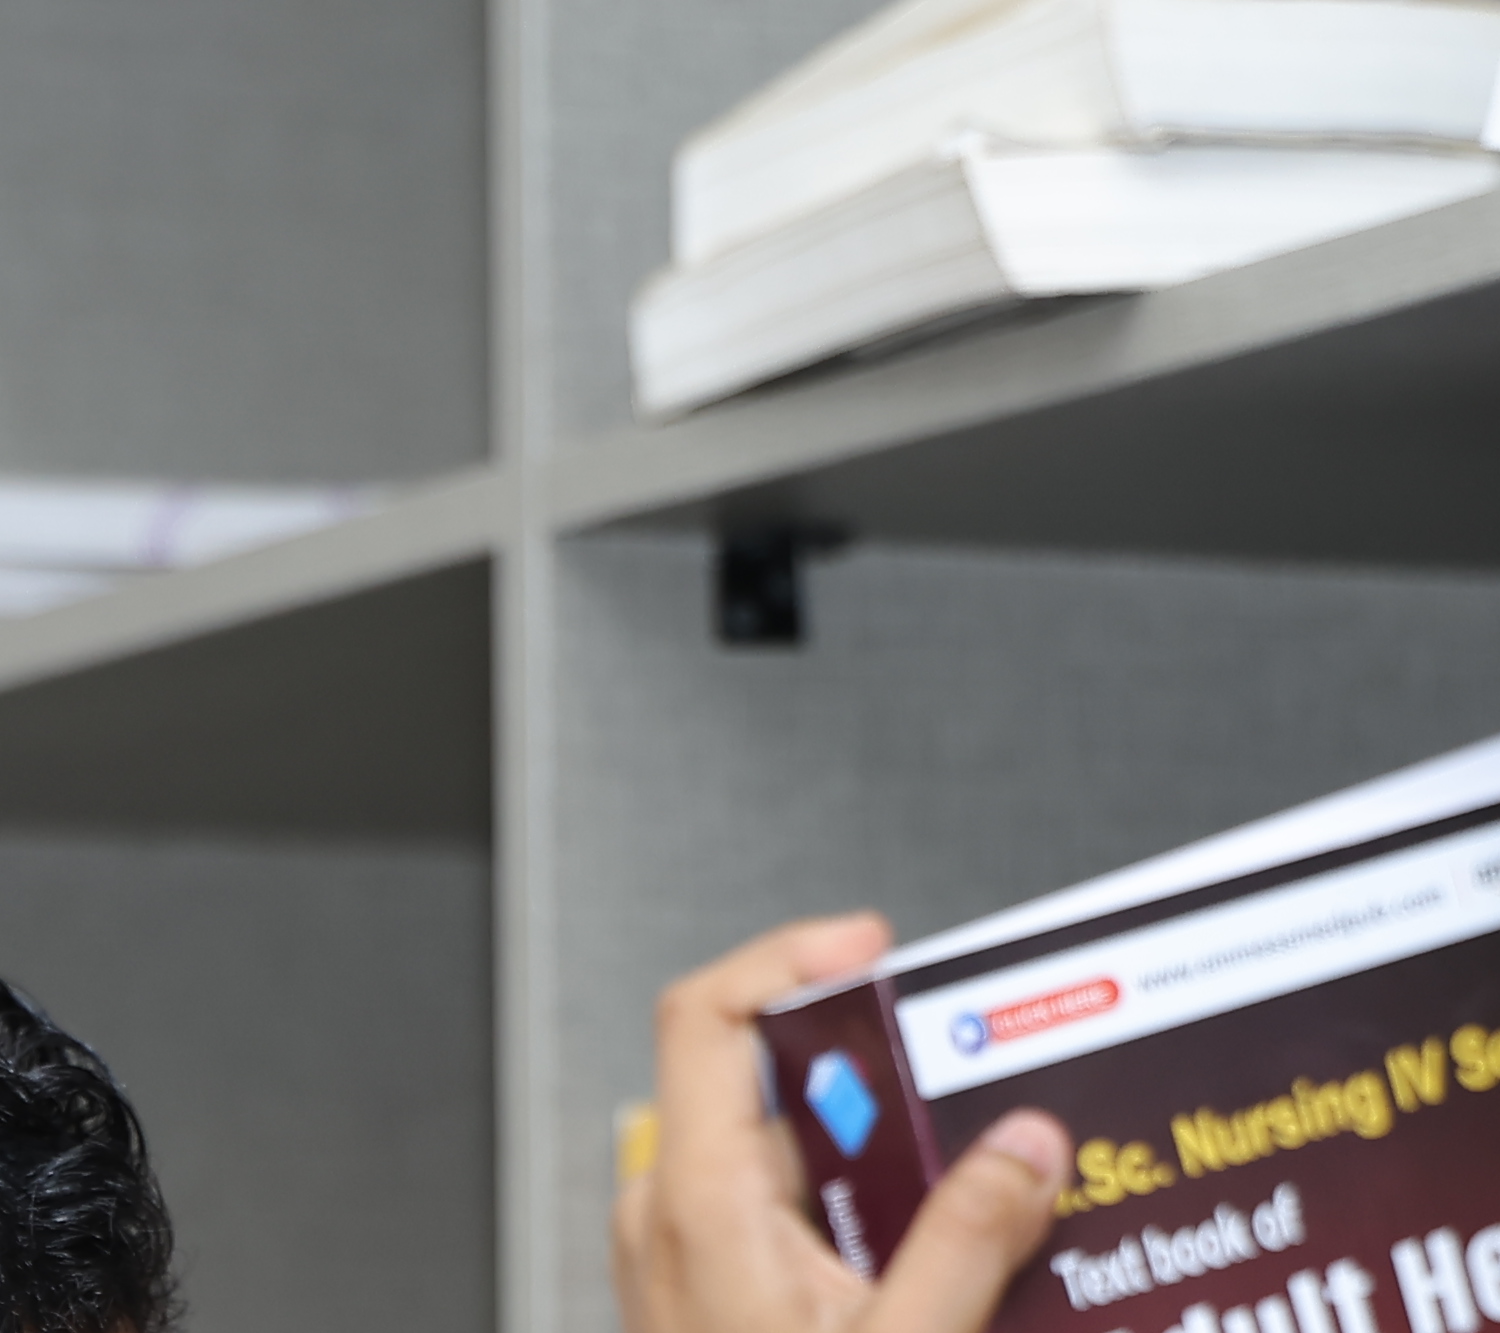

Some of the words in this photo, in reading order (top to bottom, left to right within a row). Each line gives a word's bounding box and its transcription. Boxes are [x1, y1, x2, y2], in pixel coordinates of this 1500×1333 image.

[1171, 1069, 1393, 1177] Nursing
[1384, 1036, 1447, 1112] IV
[1050, 1233, 1152, 1310] Text
[1141, 1201, 1256, 1285] book
[1252, 1180, 1304, 1253] of
